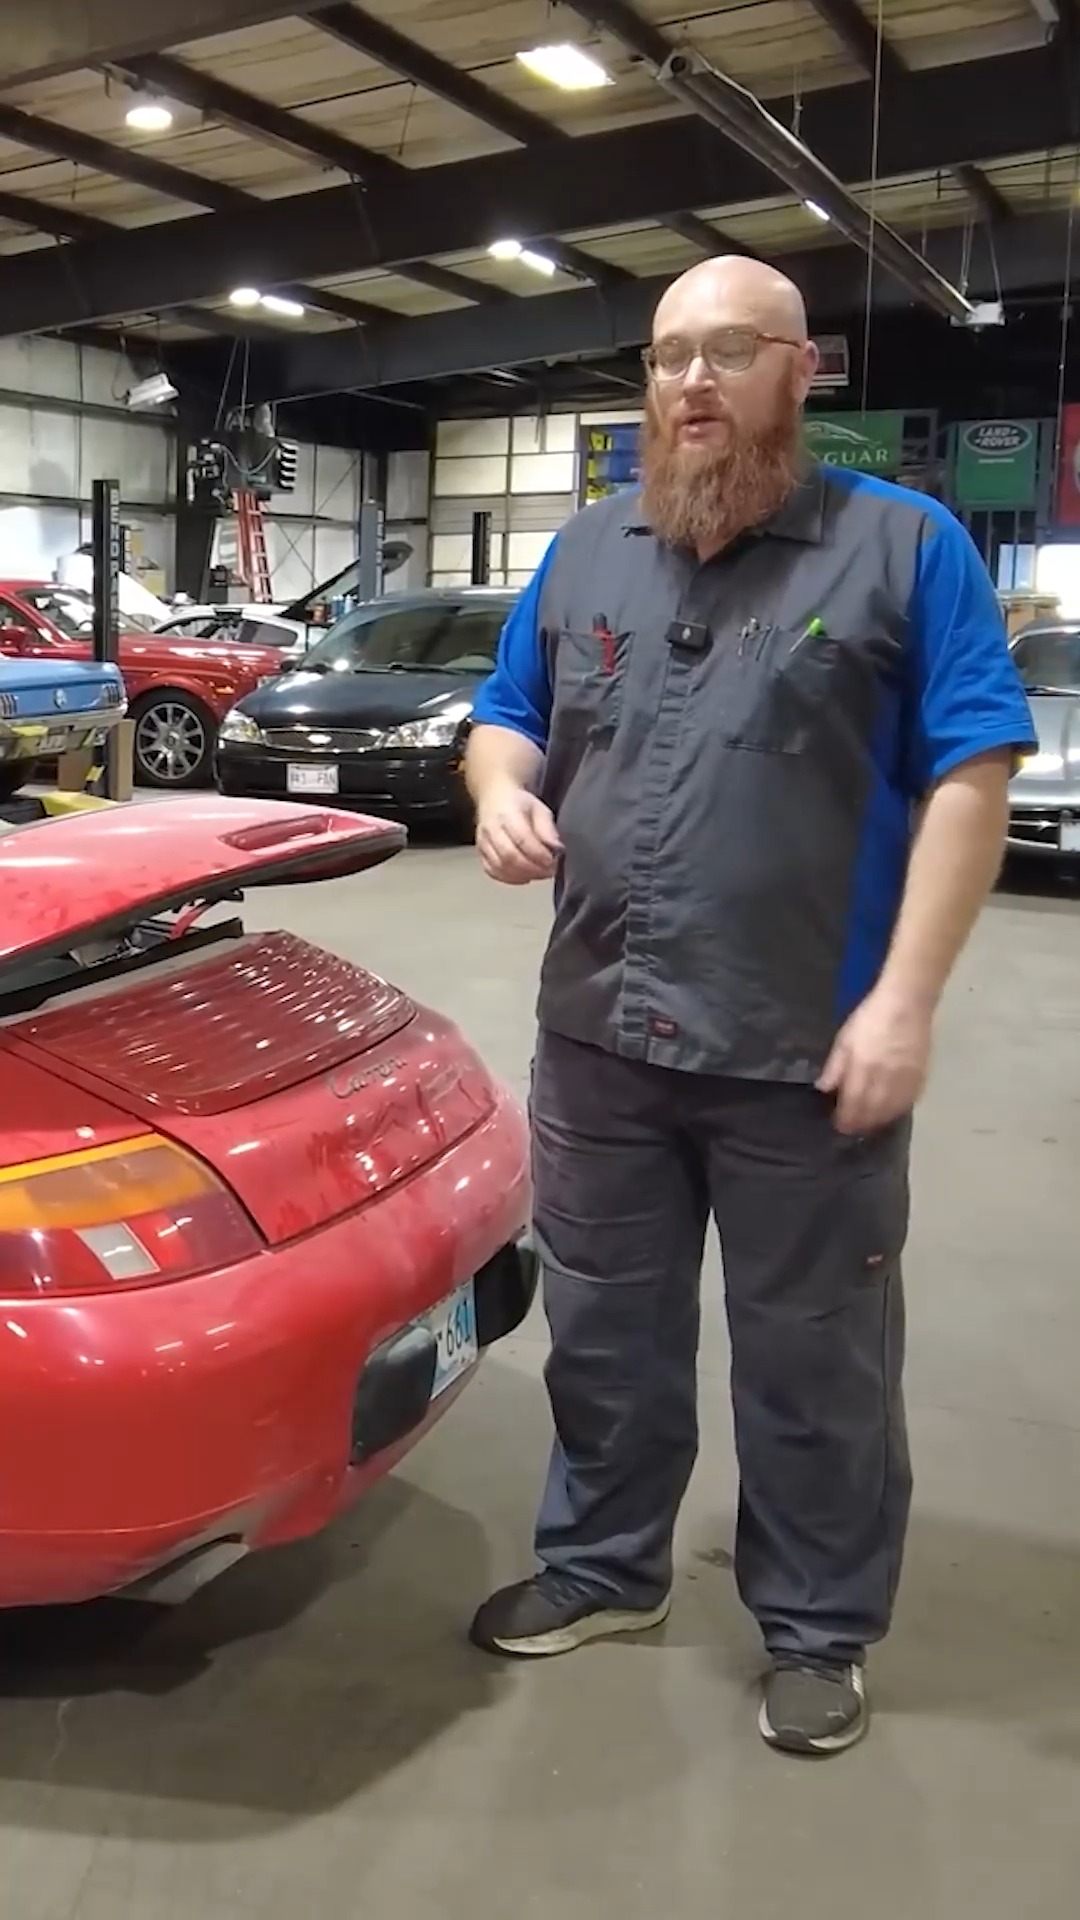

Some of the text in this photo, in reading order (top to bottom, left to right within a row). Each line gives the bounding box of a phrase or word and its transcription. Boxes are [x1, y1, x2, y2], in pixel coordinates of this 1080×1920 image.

[979, 427, 1010, 437] LAND
[980, 436, 1020, 448] ROVER
[823, 448, 889, 466] GUAR
[328, 1056, 408, 1099] Carrera
